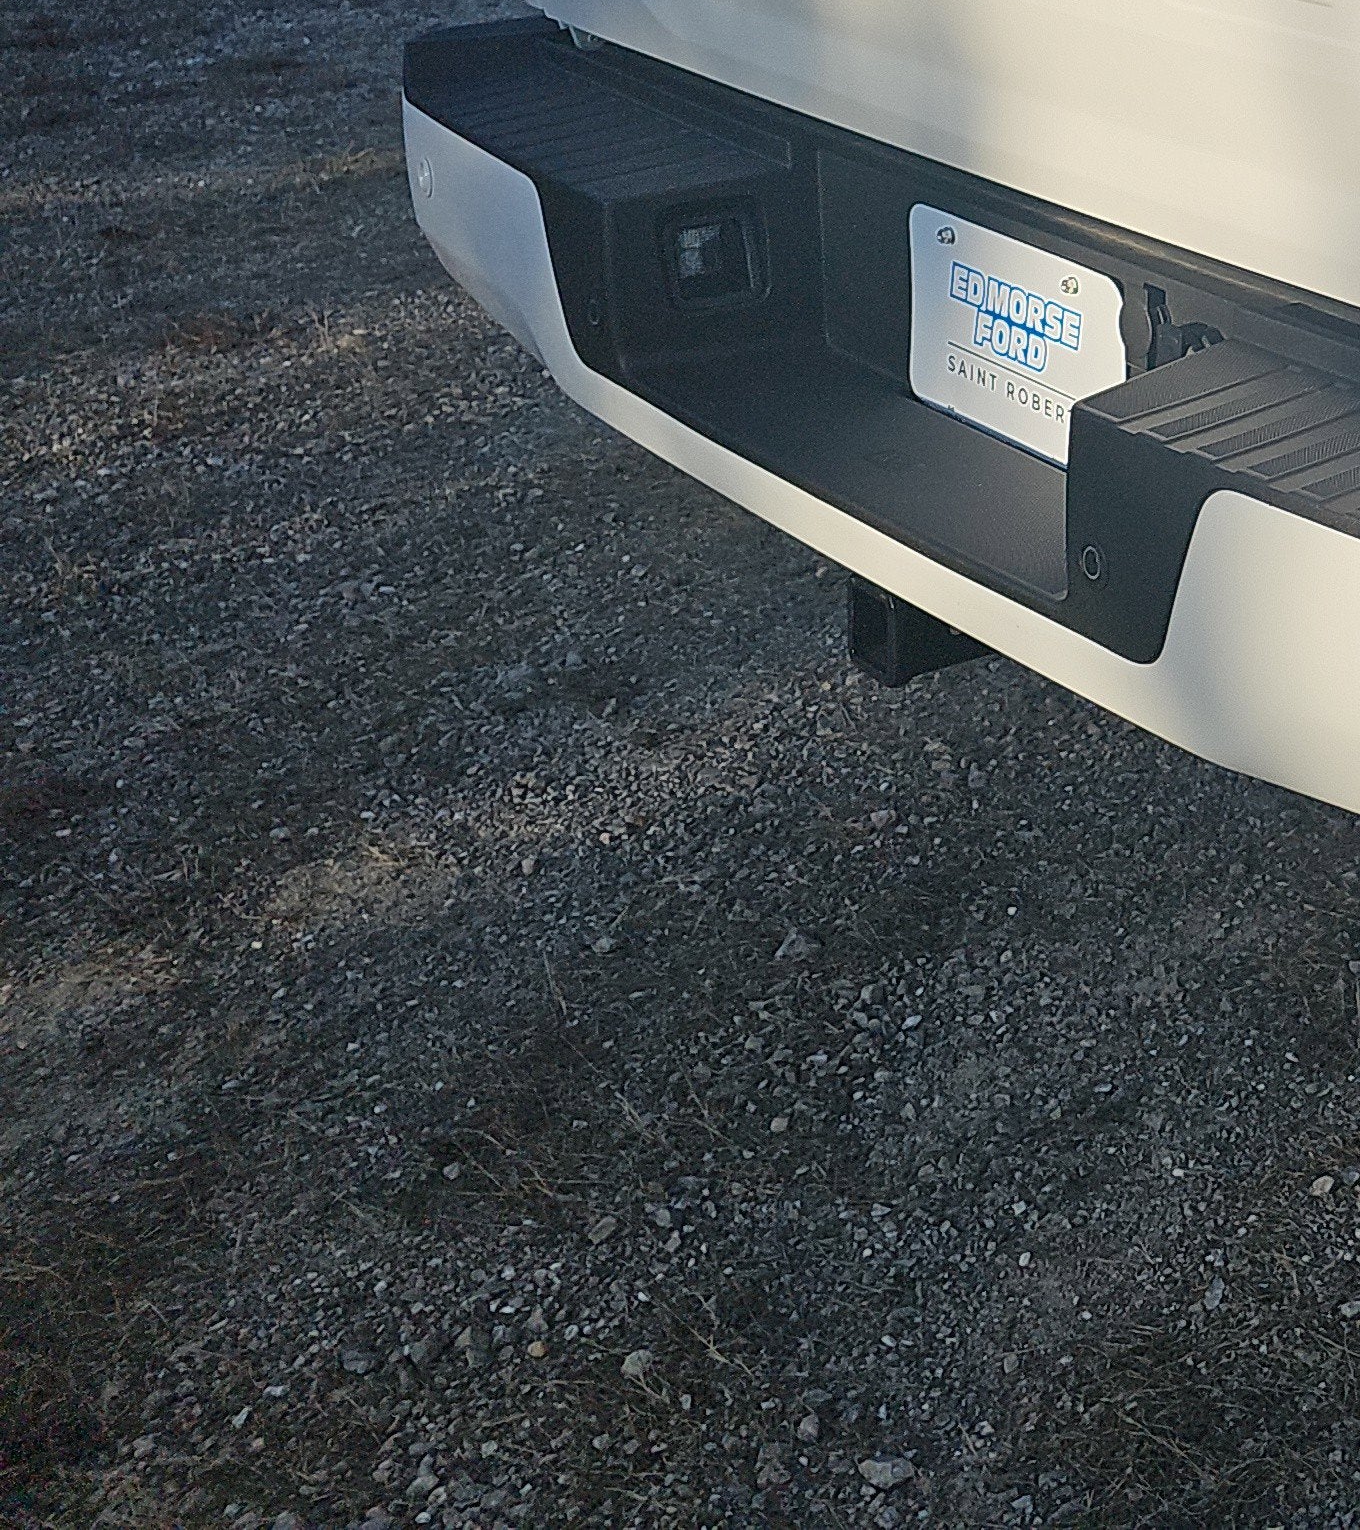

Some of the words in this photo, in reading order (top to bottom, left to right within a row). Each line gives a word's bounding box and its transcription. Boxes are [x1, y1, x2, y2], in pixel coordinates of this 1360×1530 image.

[950, 260, 986, 310] ED
[983, 275, 1082, 352] MORSE
[974, 311, 1047, 373] FORD
[947, 354, 998, 392] SAINT
[1006, 380, 1073, 423] ROBER
